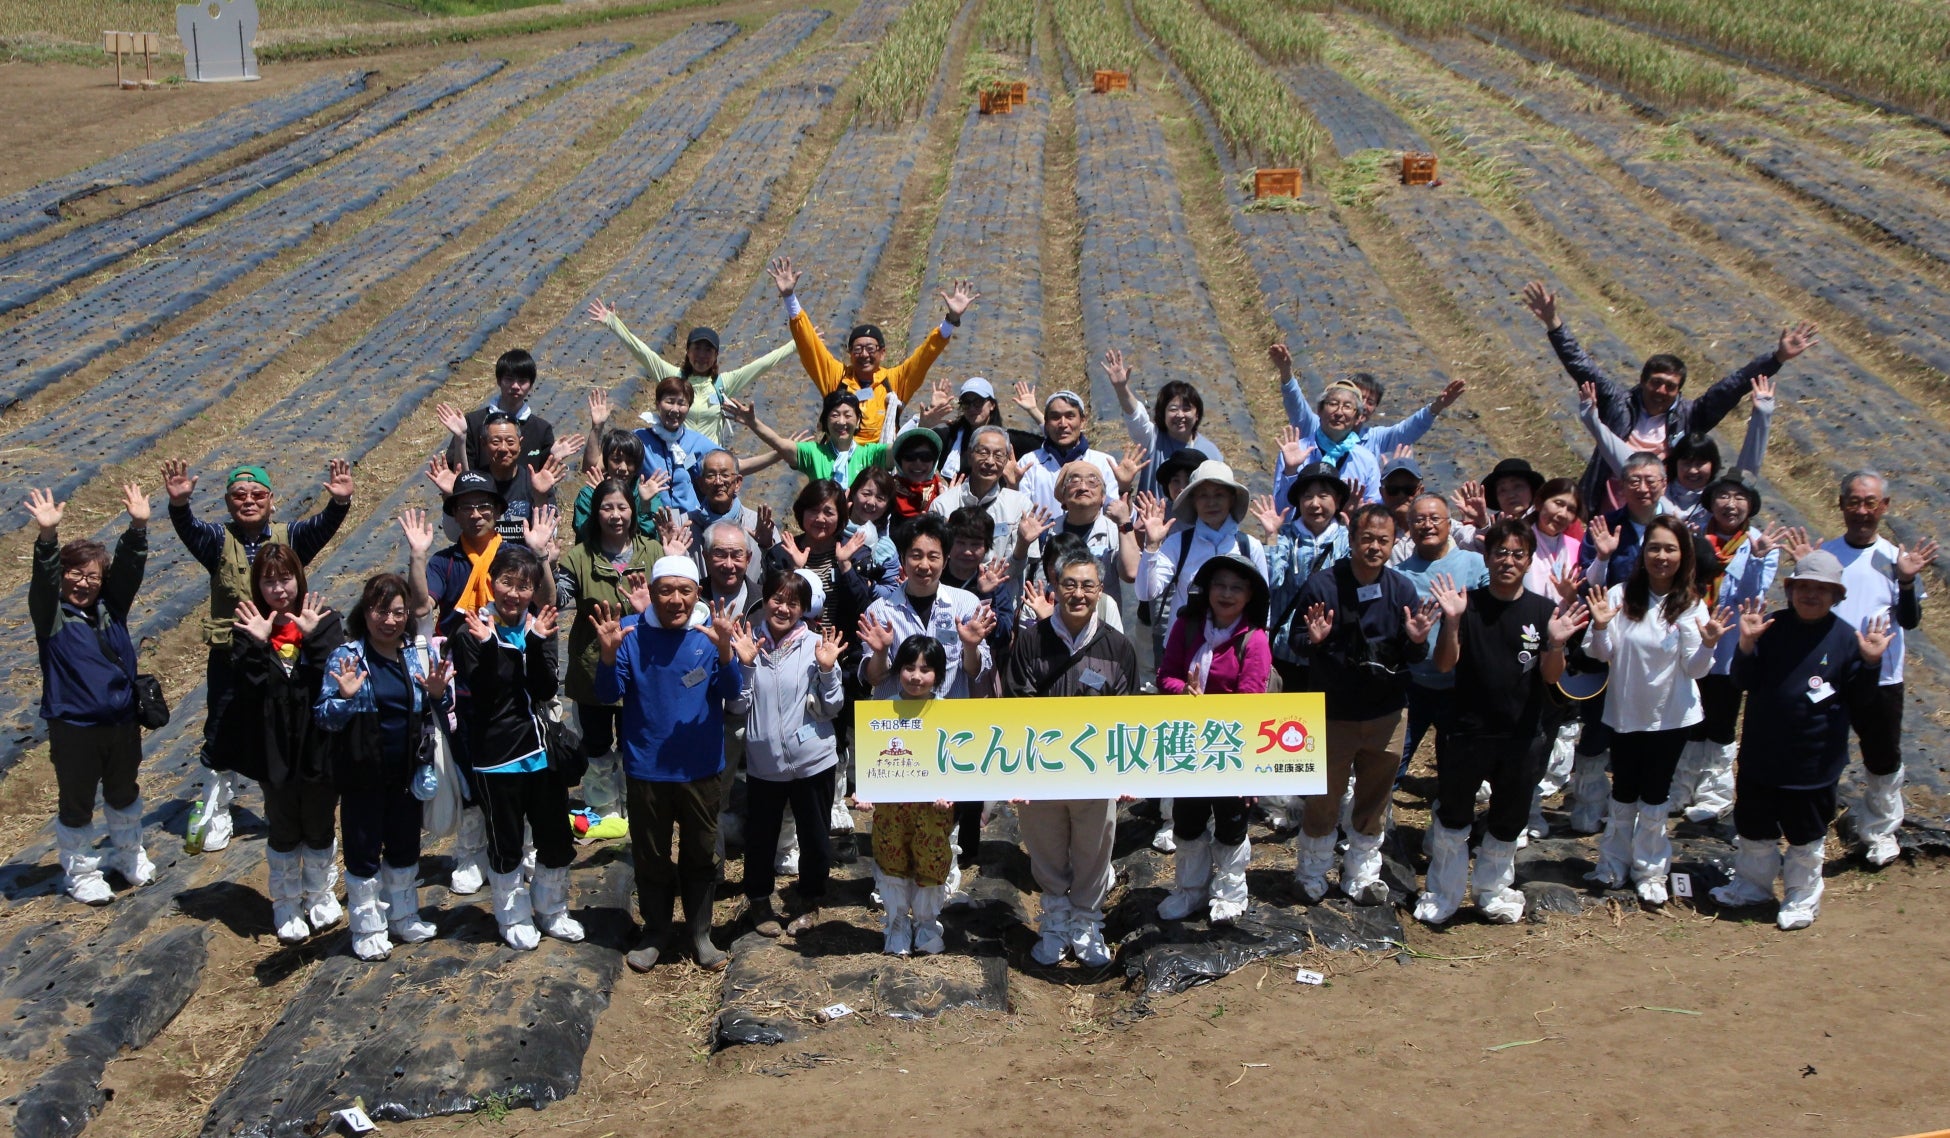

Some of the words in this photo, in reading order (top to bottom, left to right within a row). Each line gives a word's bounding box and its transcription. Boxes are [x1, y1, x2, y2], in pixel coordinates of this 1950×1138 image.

[494, 524, 525, 533] olumbi
[869, 719, 922, 731] 令和8年度
[1256, 719, 1308, 754] 50
[936, 718, 1245, 774] にんにく収穫祭
[1274, 763, 1315, 773] 健康家族
[1677, 876, 1686, 893] 5
[349, 1113, 365, 1128] 2
